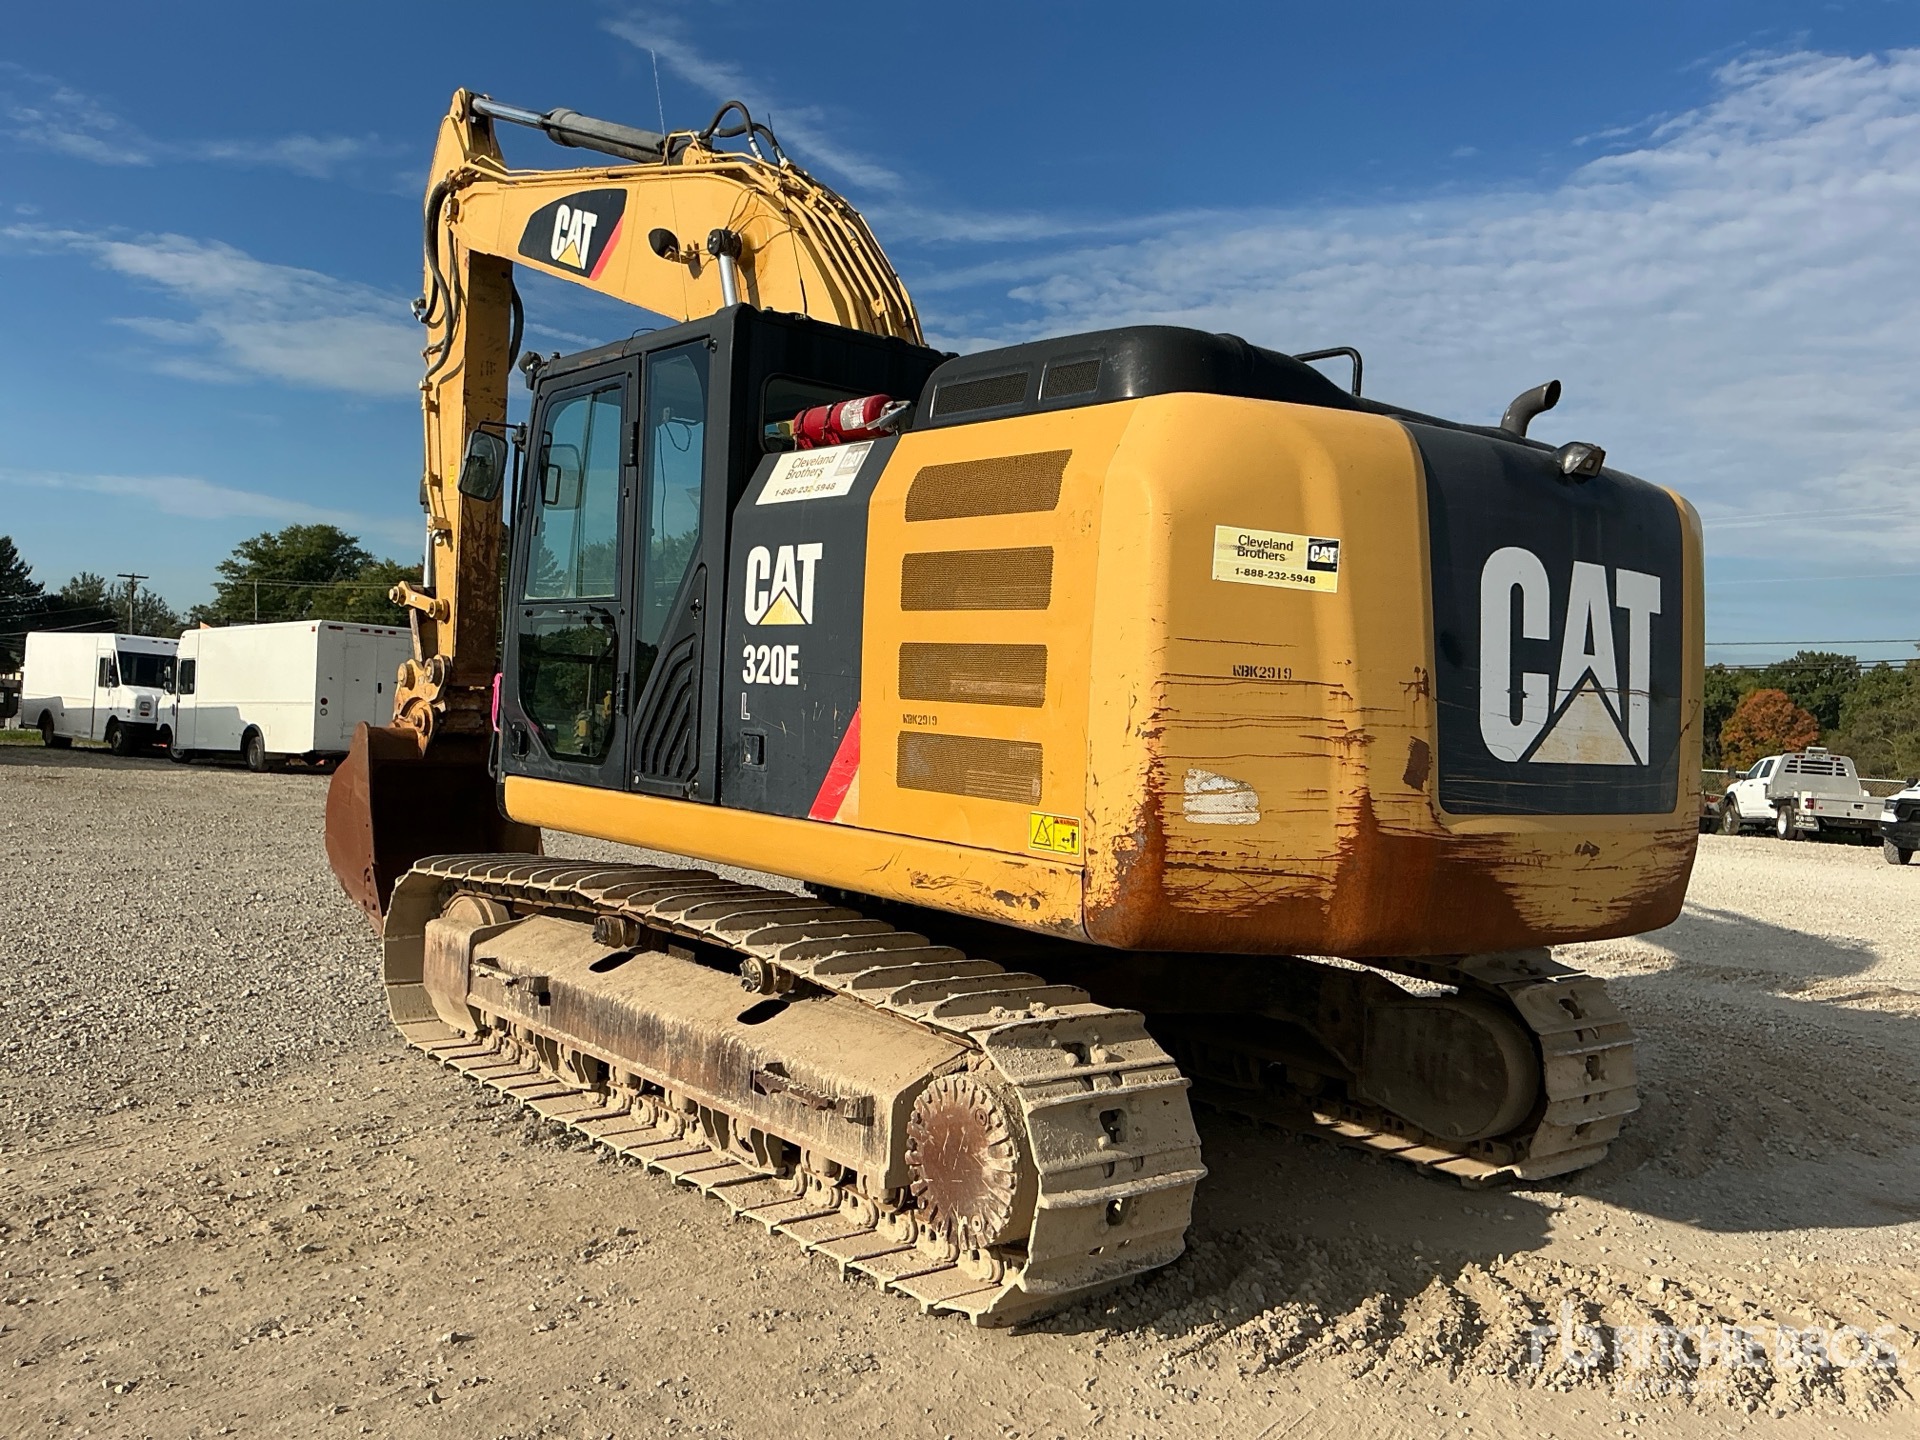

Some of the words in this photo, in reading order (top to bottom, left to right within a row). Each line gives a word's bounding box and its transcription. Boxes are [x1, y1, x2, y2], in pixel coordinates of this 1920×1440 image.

[551, 204, 598, 270] CAT
[791, 452, 837, 469] Cleveland
[785, 467, 824, 480] Brothers
[775, 482, 837, 497] 1-888-232-5948
[1238, 534, 1293, 552] Cleveland
[1237, 547, 1286, 562] Brothers
[1310, 545, 1338, 564] CAT
[744, 542, 823, 626] CAT
[1234, 567, 1316, 584] 1-888-232-5948
[742, 644, 800, 686] 320E
[1479, 546, 1661, 766] CAT
[741, 692, 750, 720] L
